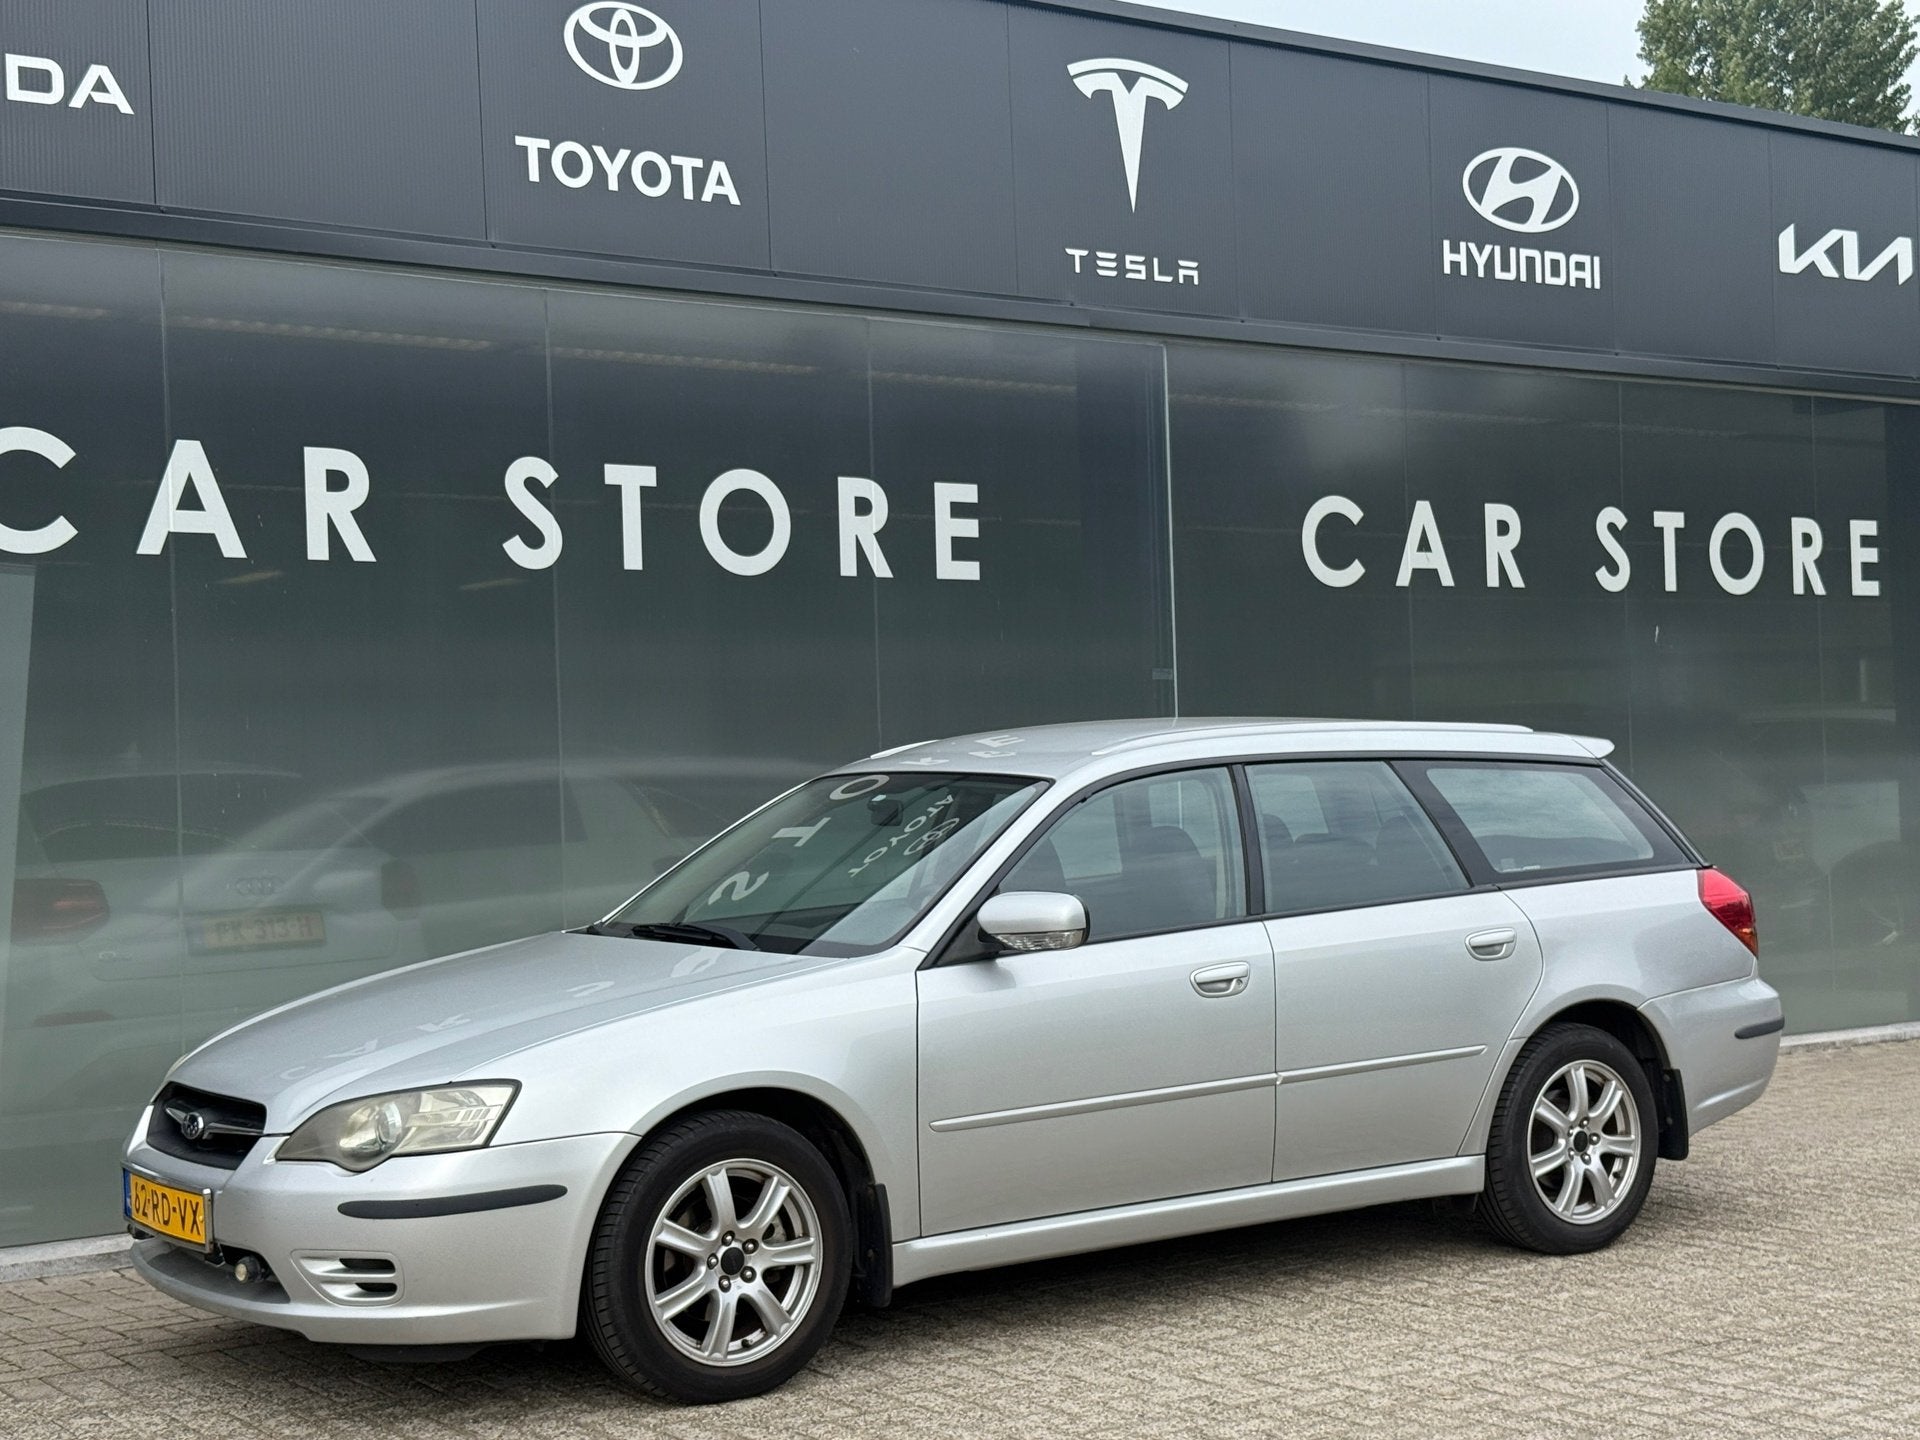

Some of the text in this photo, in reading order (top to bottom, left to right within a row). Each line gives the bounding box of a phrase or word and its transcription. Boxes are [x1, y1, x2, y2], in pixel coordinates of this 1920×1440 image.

[4, 52, 135, 115] DA
[514, 135, 741, 206] TOYOTA
[1064, 247, 1199, 286] TESLA
[1442, 239, 1601, 290] HYUNDAI
[1778, 223, 1914, 286] KIA
[0, 426, 981, 581] CAR STORE
[1301, 495, 1880, 596] CAR STORE
[134, 1182, 202, 1237] 62-RD-VX
